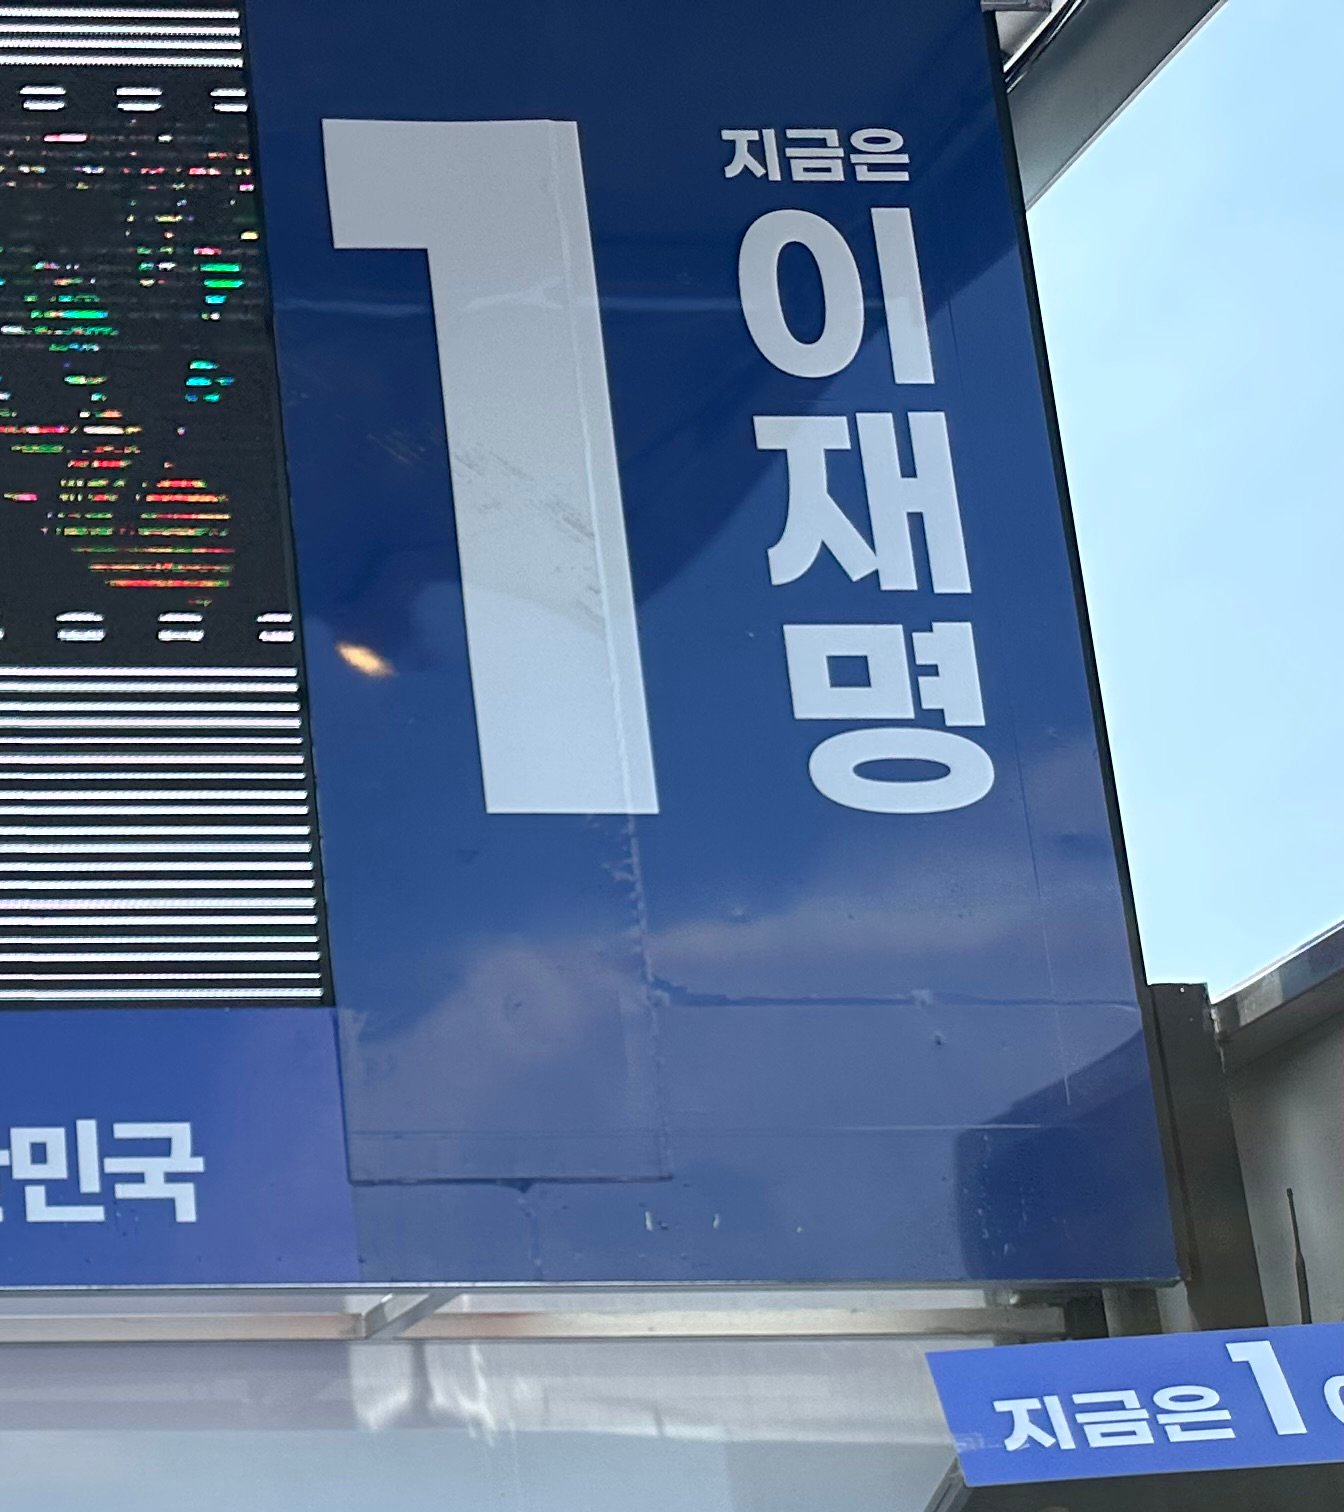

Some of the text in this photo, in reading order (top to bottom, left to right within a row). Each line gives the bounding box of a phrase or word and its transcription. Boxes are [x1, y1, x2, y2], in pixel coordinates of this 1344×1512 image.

[722, 129, 910, 182] 지금은
[322, 119, 660, 814] 1
[739, 207, 995, 813] 이재명
[993, 1385, 1236, 1452] 지금은
[1225, 1340, 1308, 1436] 1
